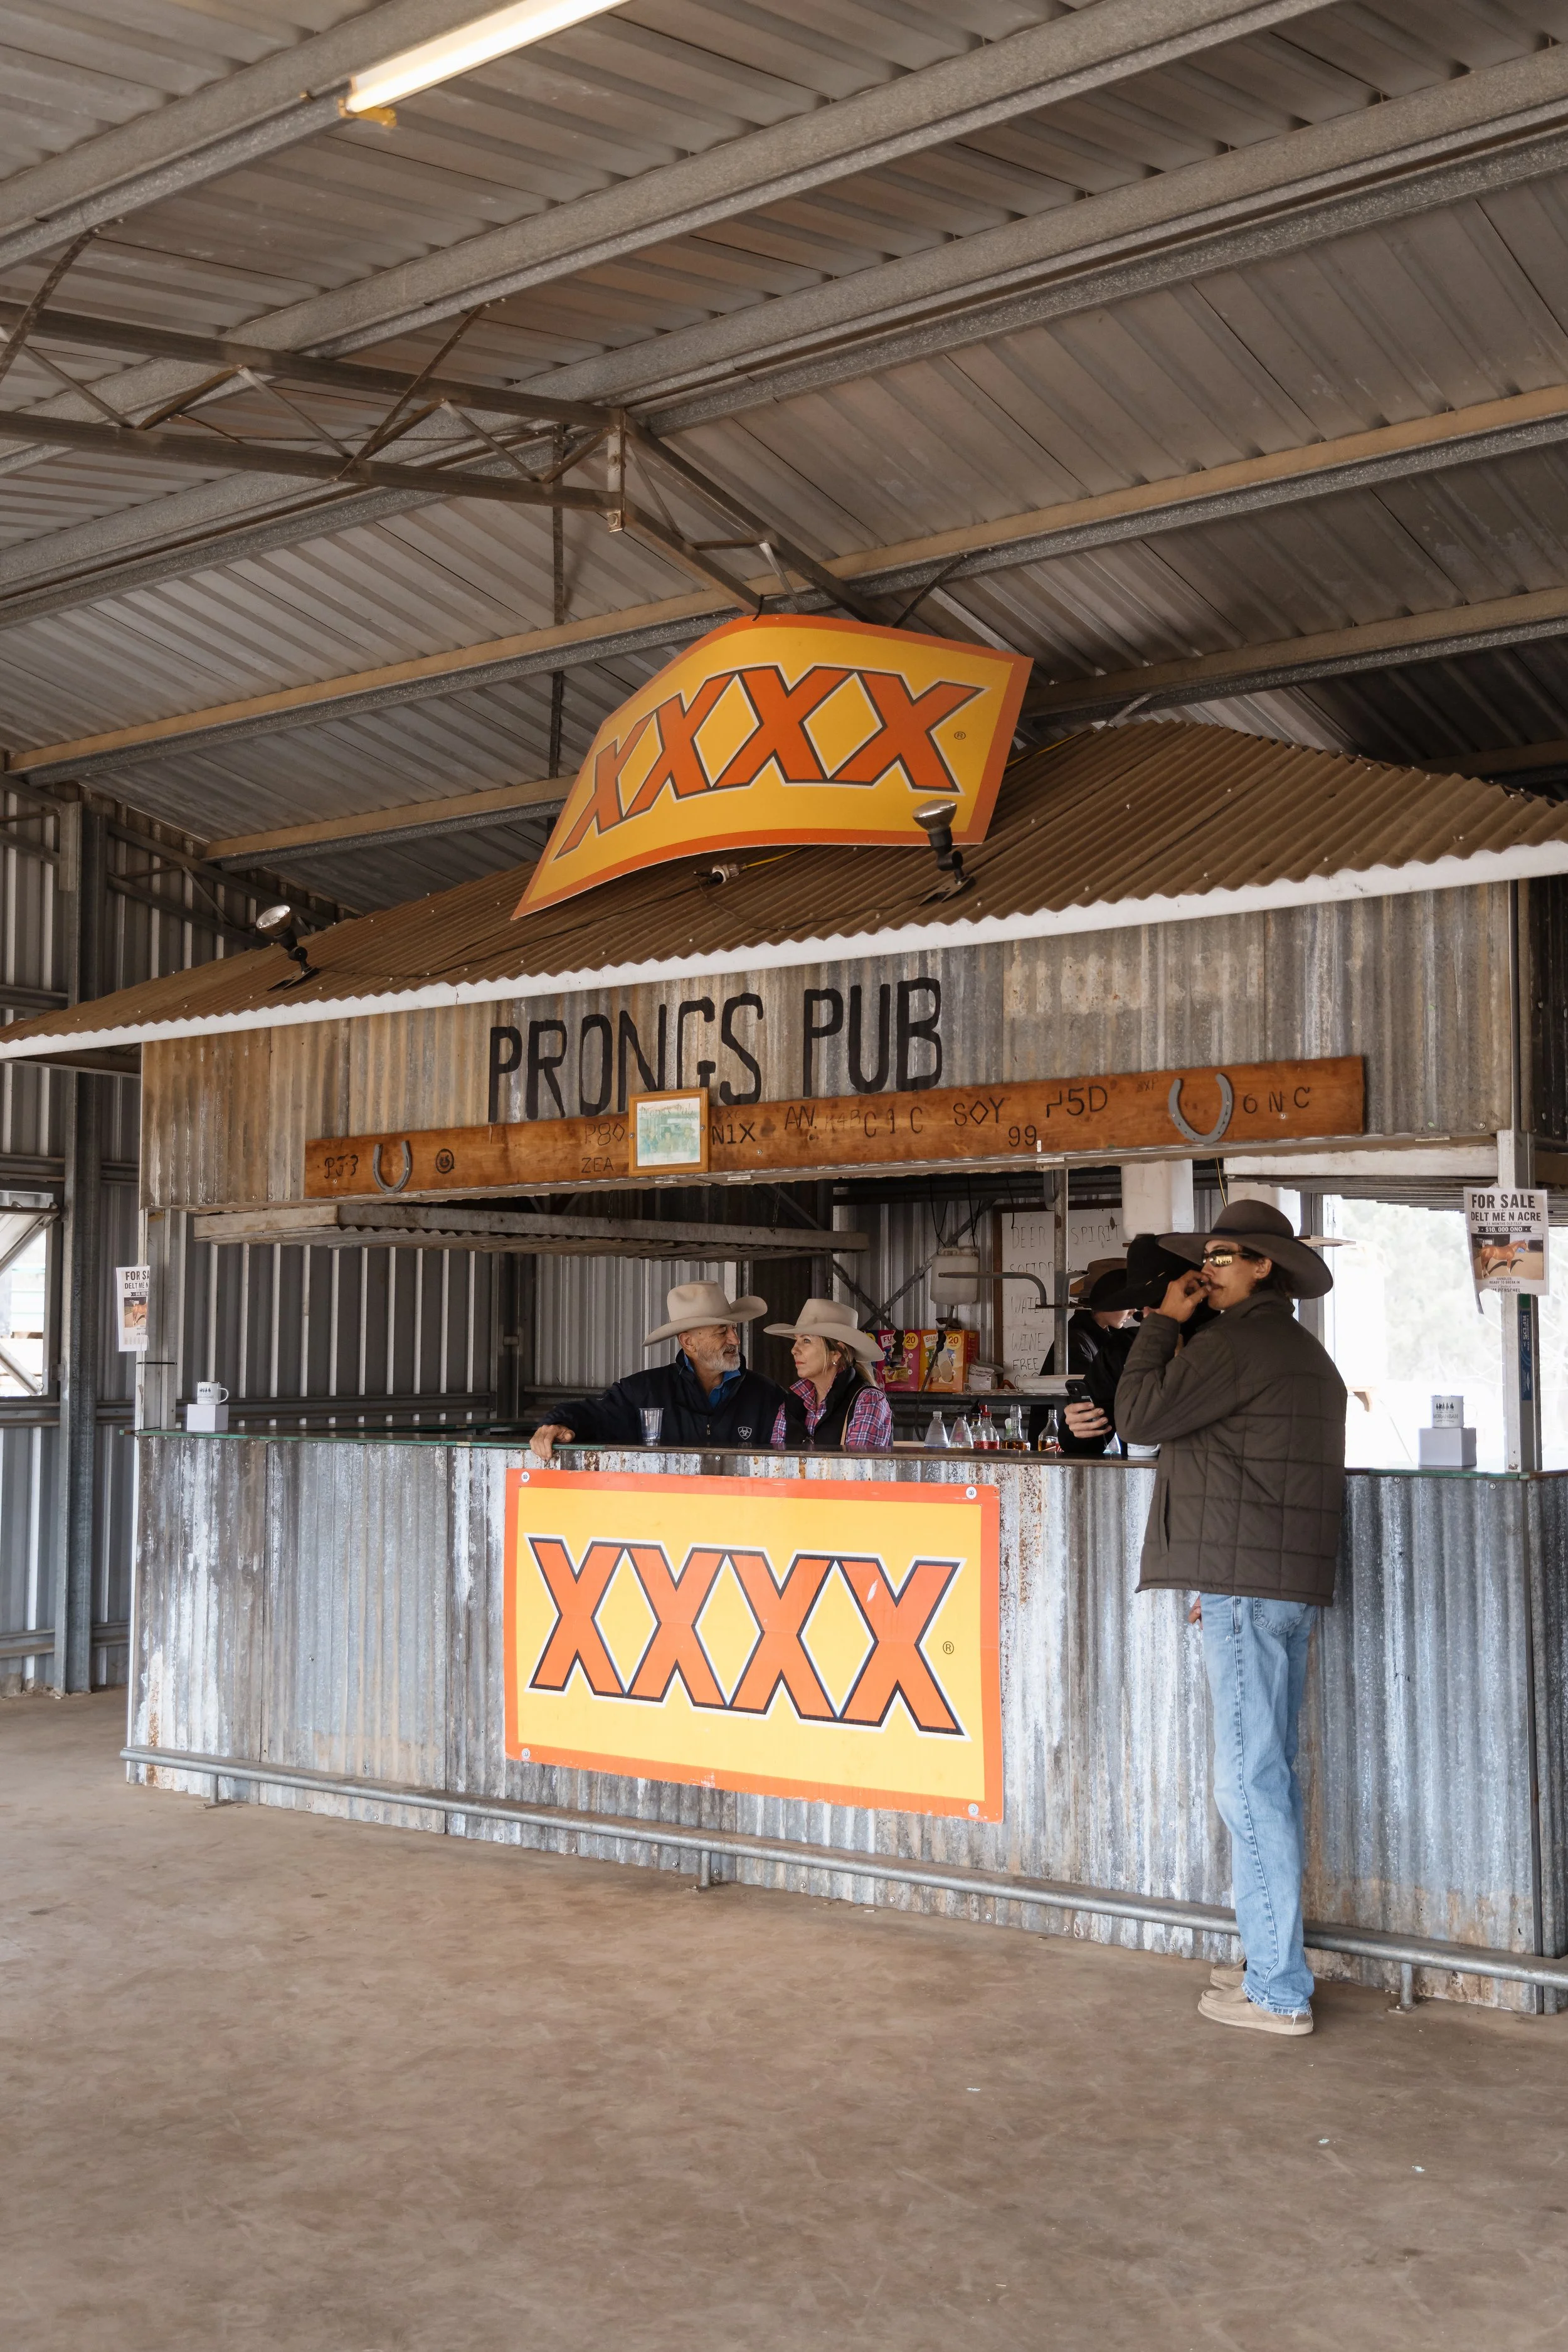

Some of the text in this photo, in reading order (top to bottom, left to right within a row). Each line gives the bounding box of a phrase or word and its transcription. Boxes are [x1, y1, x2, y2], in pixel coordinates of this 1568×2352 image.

[554, 663, 989, 862] XXXX
[488, 977, 943, 1123] PRONGS PUB
[1009, 1125, 1037, 1153] 99
[581, 1157, 614, 1173] ZEA
[1471, 1194, 1536, 1209] FOR SALE
[1471, 1211, 1542, 1222] DELT ME N ACRE
[1012, 1226, 1046, 1249] BEER
[125, 1270, 150, 1281] FOR SA
[906, 1336, 916, 1344] 20
[948, 1336, 959, 1344] 20
[1012, 1332, 1046, 1352] WINE
[1012, 1357, 1039, 1370] FREE
[523, 1532, 972, 1742] XXXX
